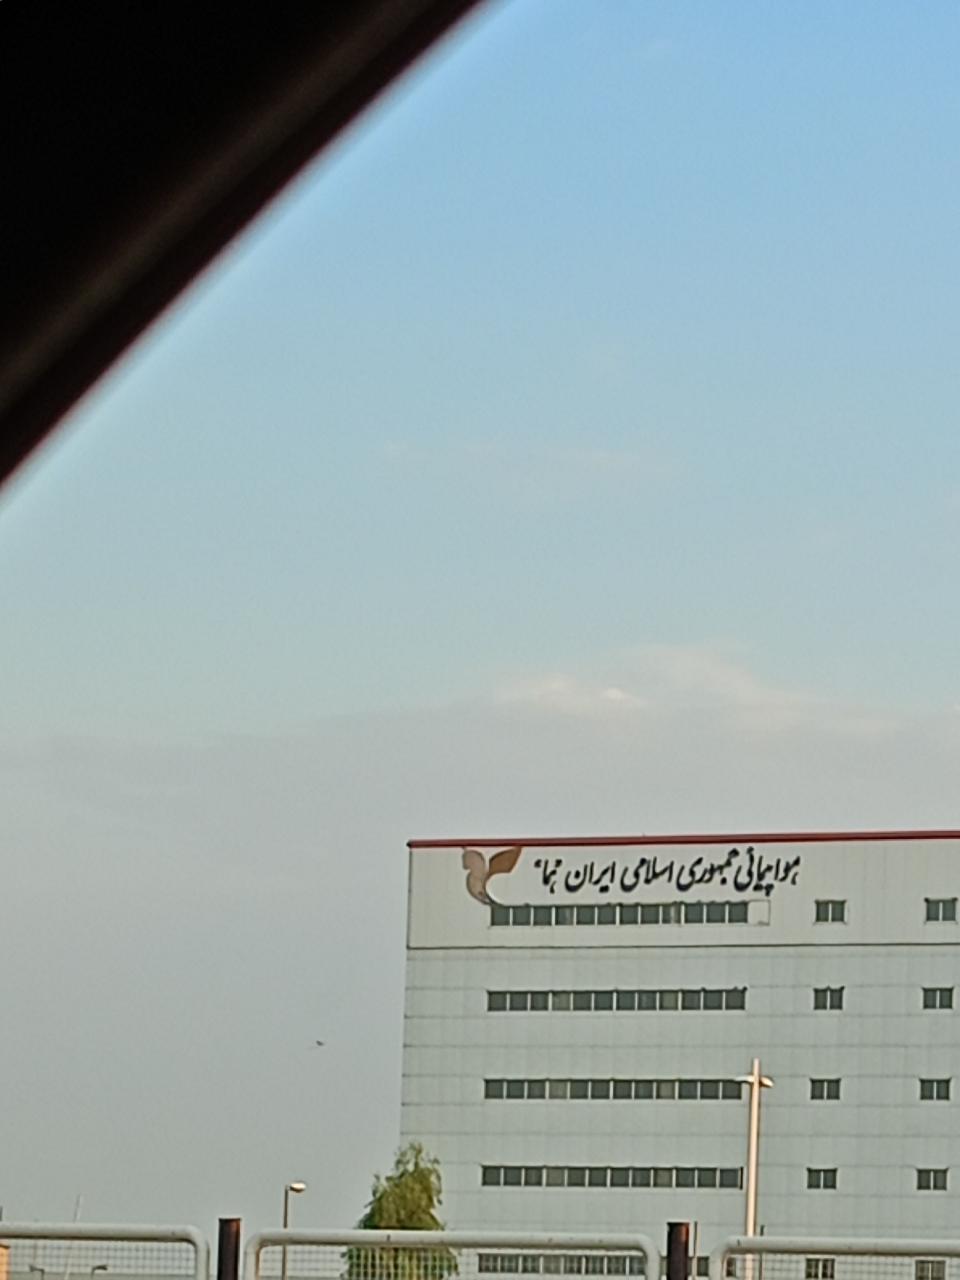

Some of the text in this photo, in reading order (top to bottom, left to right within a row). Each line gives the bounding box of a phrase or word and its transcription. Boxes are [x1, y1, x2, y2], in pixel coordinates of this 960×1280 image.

[564, 861, 616, 893] ایران
[620, 857, 674, 893] اسلامی
[676, 848, 740, 892] جمهوری
